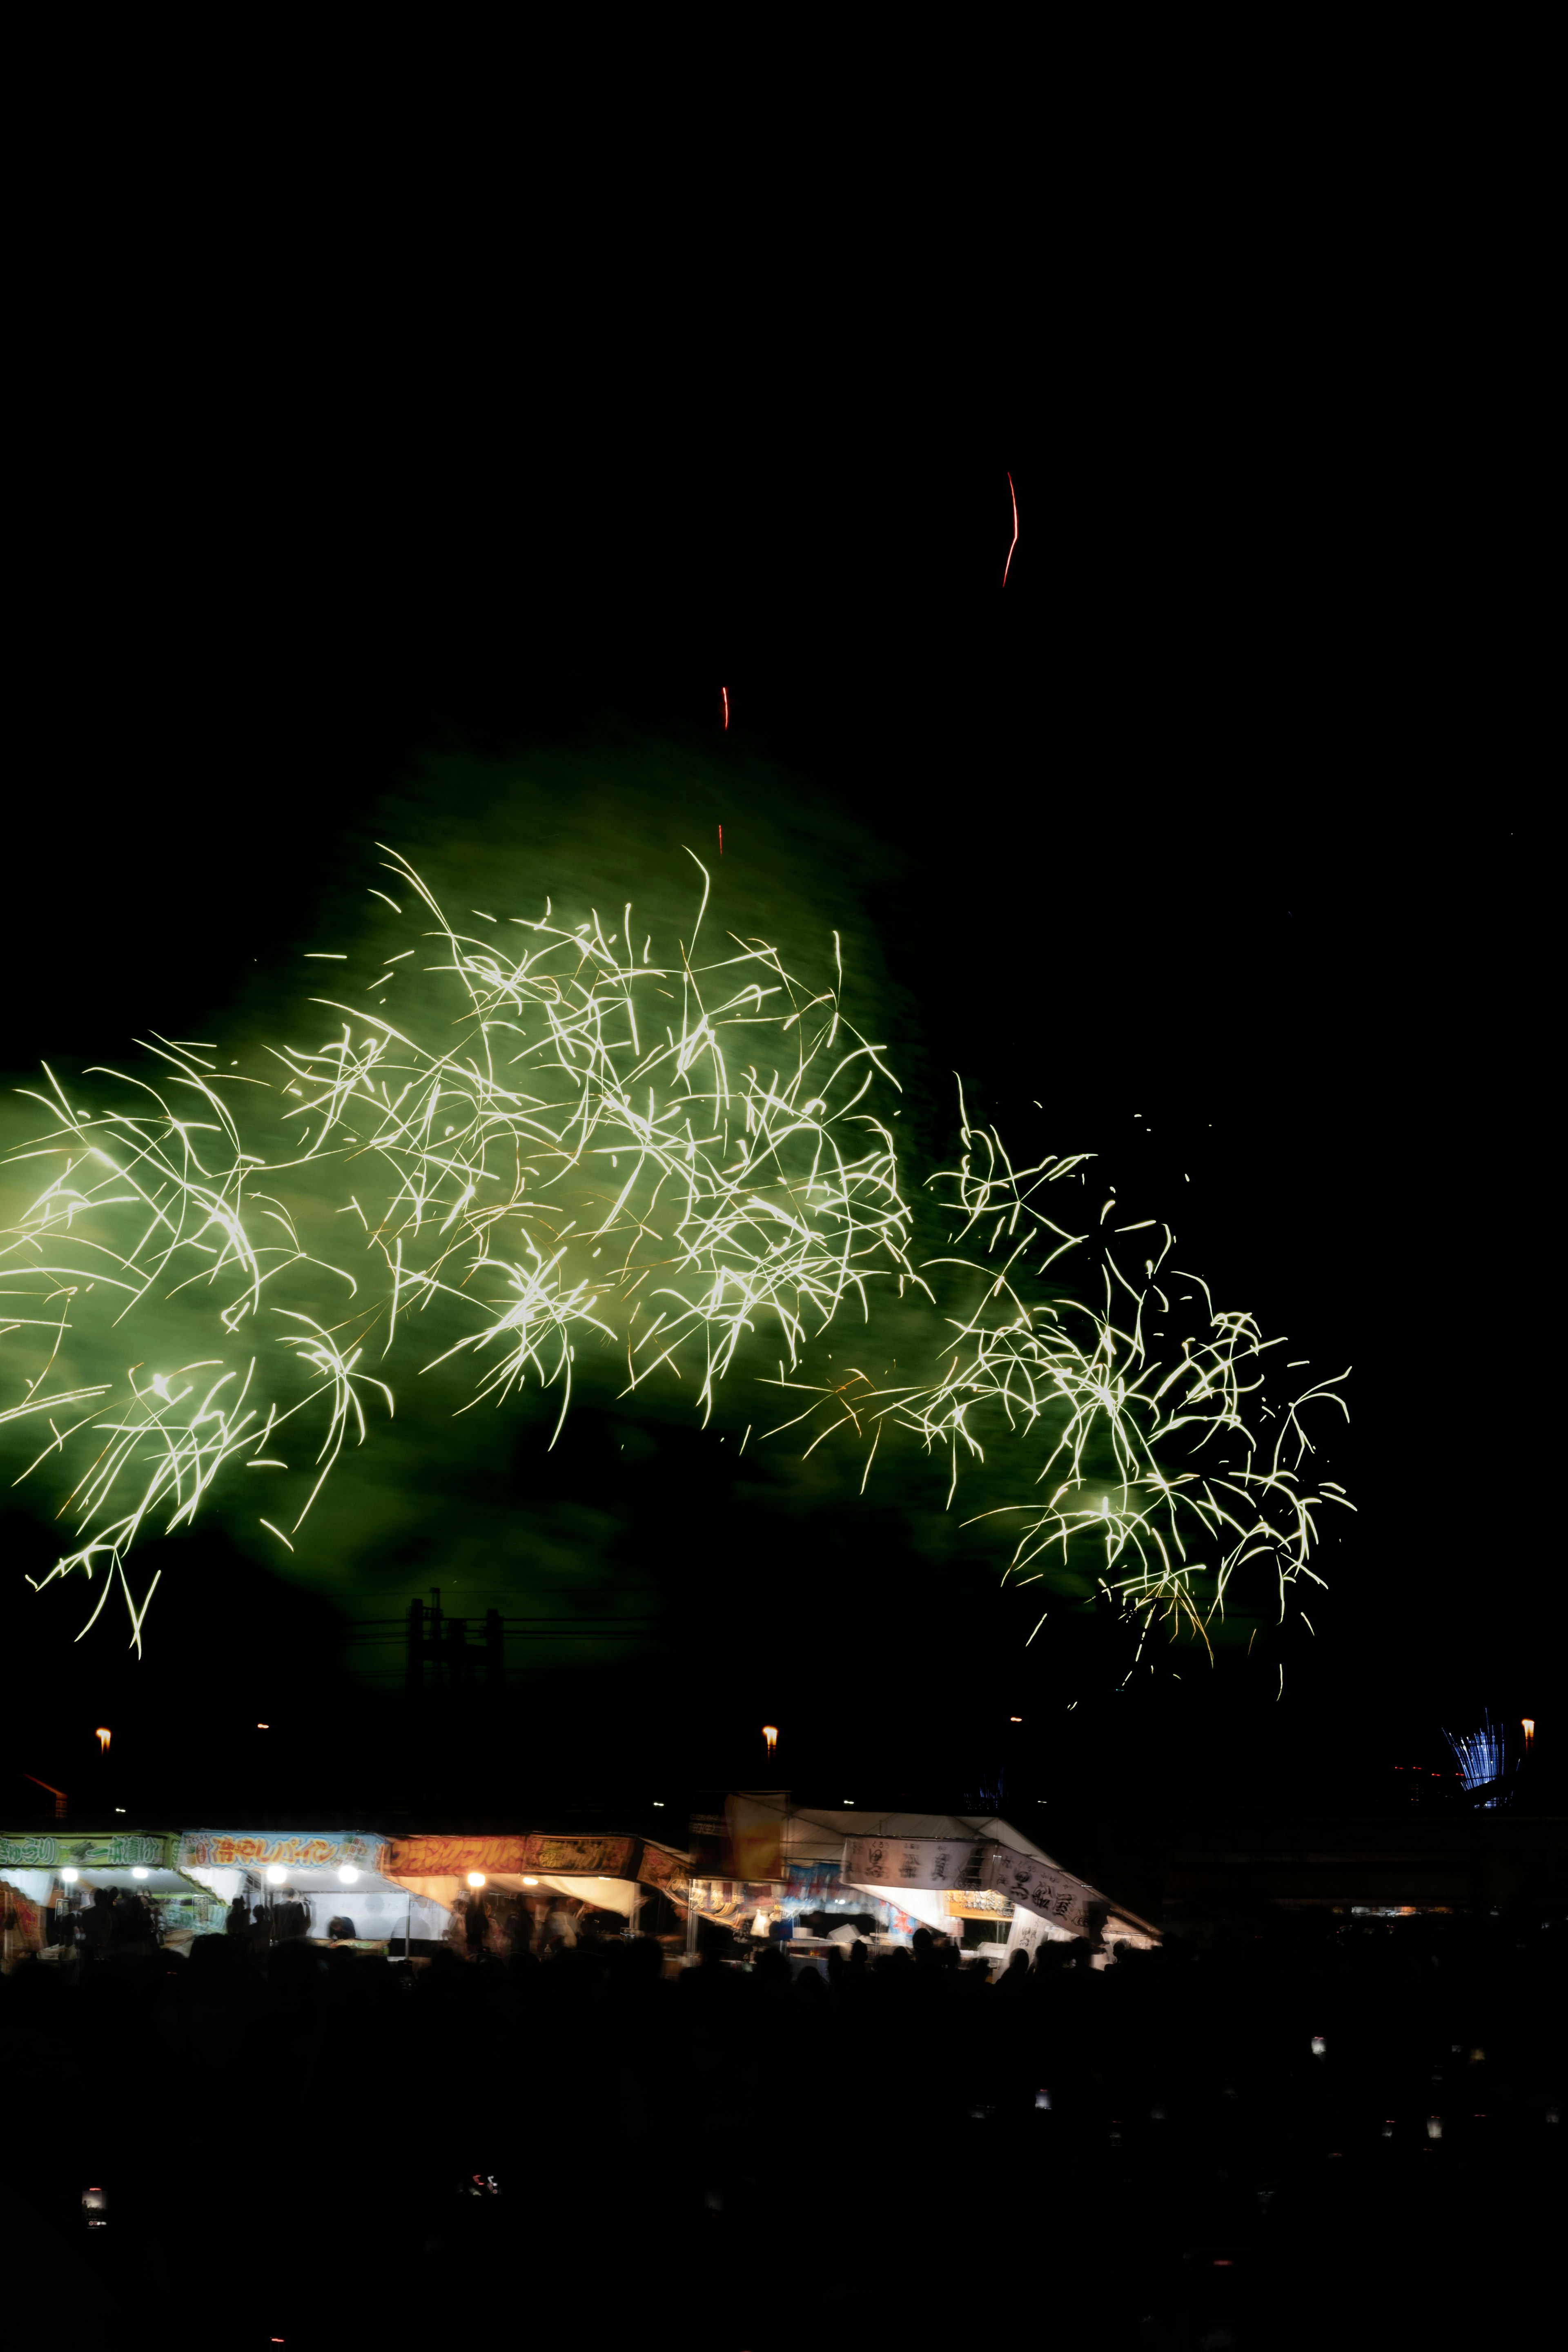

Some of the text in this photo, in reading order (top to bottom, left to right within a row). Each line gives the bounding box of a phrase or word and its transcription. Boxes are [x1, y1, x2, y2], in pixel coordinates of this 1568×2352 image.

[85, 1836, 158, 1864] 一本漬け
[211, 1836, 338, 1865] 冷やしパイン
